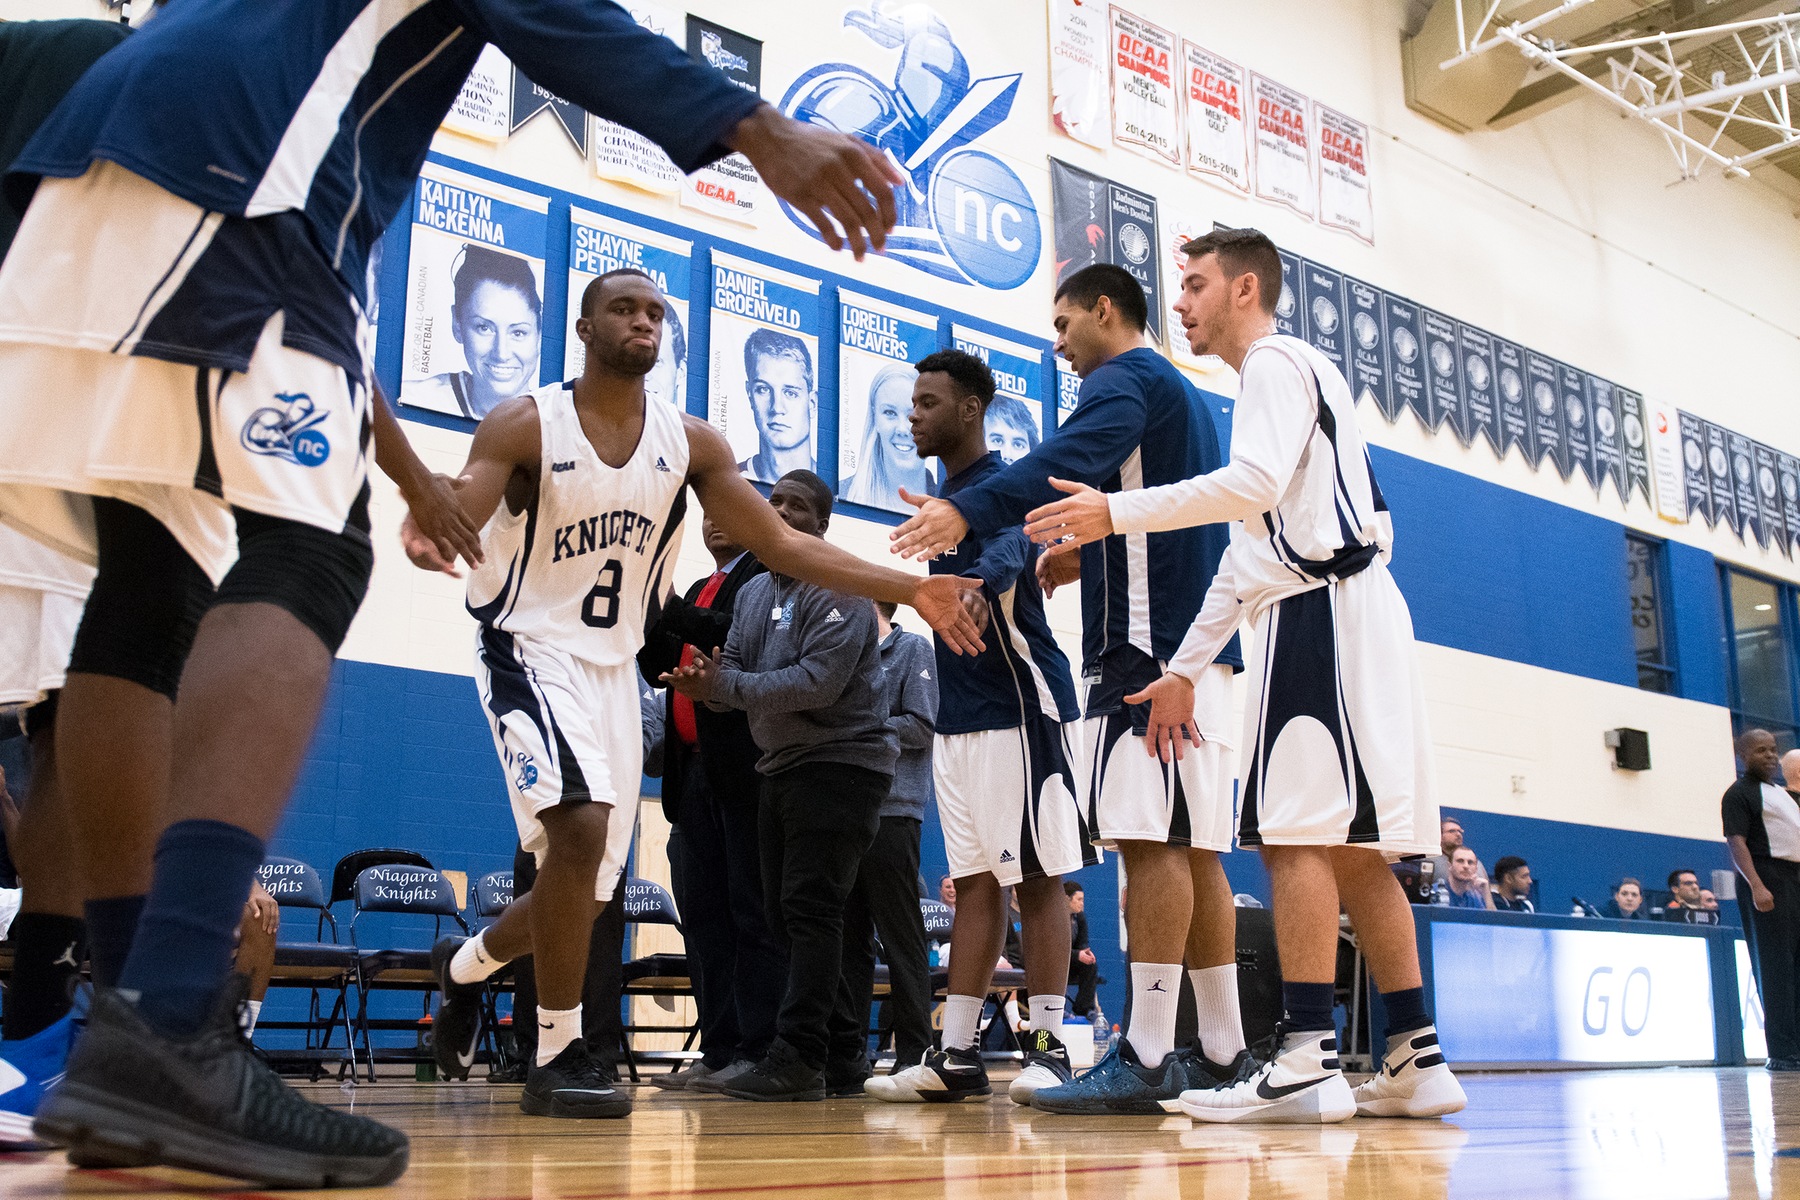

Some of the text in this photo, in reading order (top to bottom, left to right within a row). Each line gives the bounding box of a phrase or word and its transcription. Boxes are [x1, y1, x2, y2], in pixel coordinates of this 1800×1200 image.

[1118, 33, 1169, 71] OCAA
[1123, 81, 1167, 108] VOLLEYBALL
[1133, 75, 1157, 93] MEN'S
[1192, 67, 1238, 103] OCAA
[1205, 107, 1228, 125] MEN'S
[1208, 119, 1226, 133] GOLF
[1258, 97, 1304, 133] OCAA
[604, 135, 666, 162] CHAMPIONS
[1321, 127, 1364, 161] OCAA
[1198, 152, 1239, 178] 2015-2016
[421, 178, 491, 220] KAITLYN
[1112, 200, 1154, 224] Men's Doubles
[1115, 189, 1150, 213] Badminton
[419, 200, 505, 245] McKENNA
[954, 185, 1023, 253] nc
[575, 226, 644, 265] SHAYNE
[715, 267, 768, 301] DANIEL
[715, 289, 800, 329] GROENVELD
[842, 305, 898, 339] LORELLE
[421, 316, 433, 374] BASKETBALL
[843, 325, 908, 360] WEAVERS
[297, 438, 325, 459] nc
[553, 509, 656, 564] KNIGHT
[580, 558, 624, 629] 8
[369, 869, 440, 887] Niagara
[375, 885, 438, 905] Knights
[1582, 966, 1652, 1037] GO
